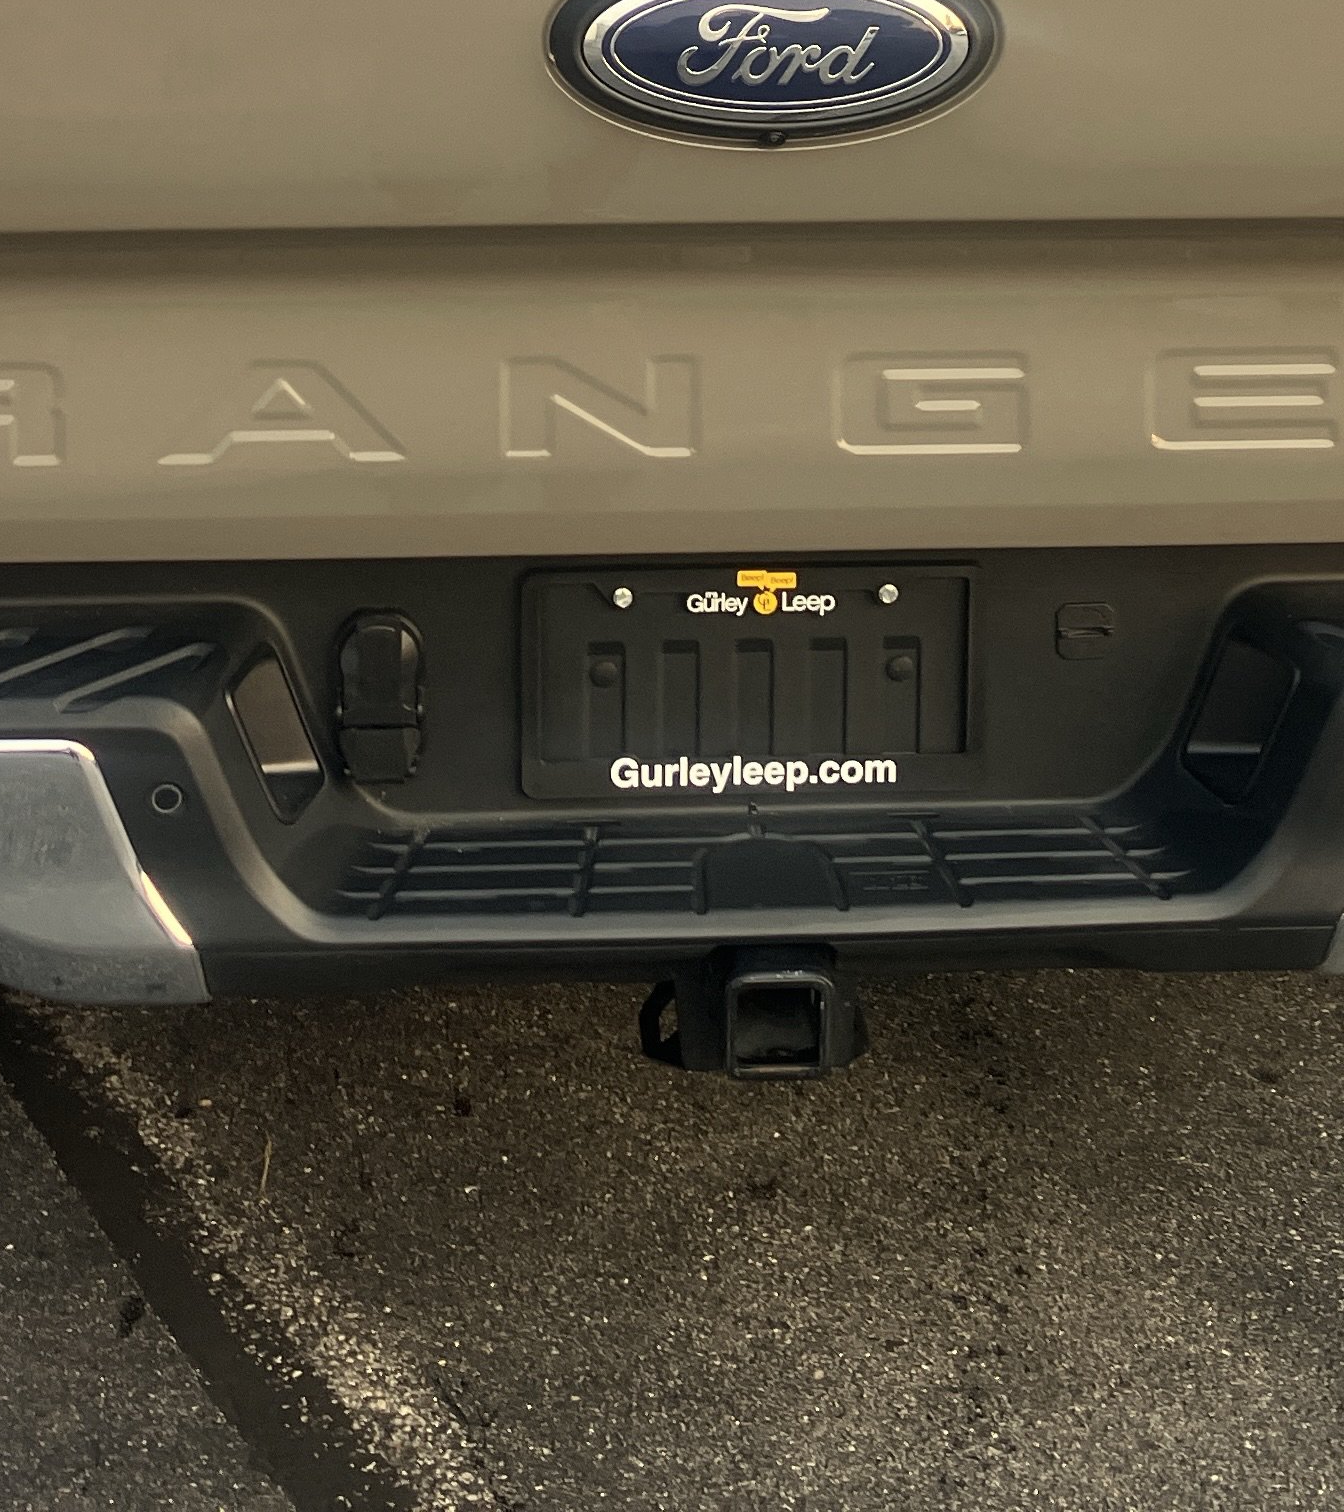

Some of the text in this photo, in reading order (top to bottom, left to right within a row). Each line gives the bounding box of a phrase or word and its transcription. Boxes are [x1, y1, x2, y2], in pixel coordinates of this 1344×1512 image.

[677, 3, 879, 87] Ford
[686, 592, 749, 617] Gurley
[781, 591, 836, 617] Leep
[610, 755, 897, 794] Gurleyleep.com
